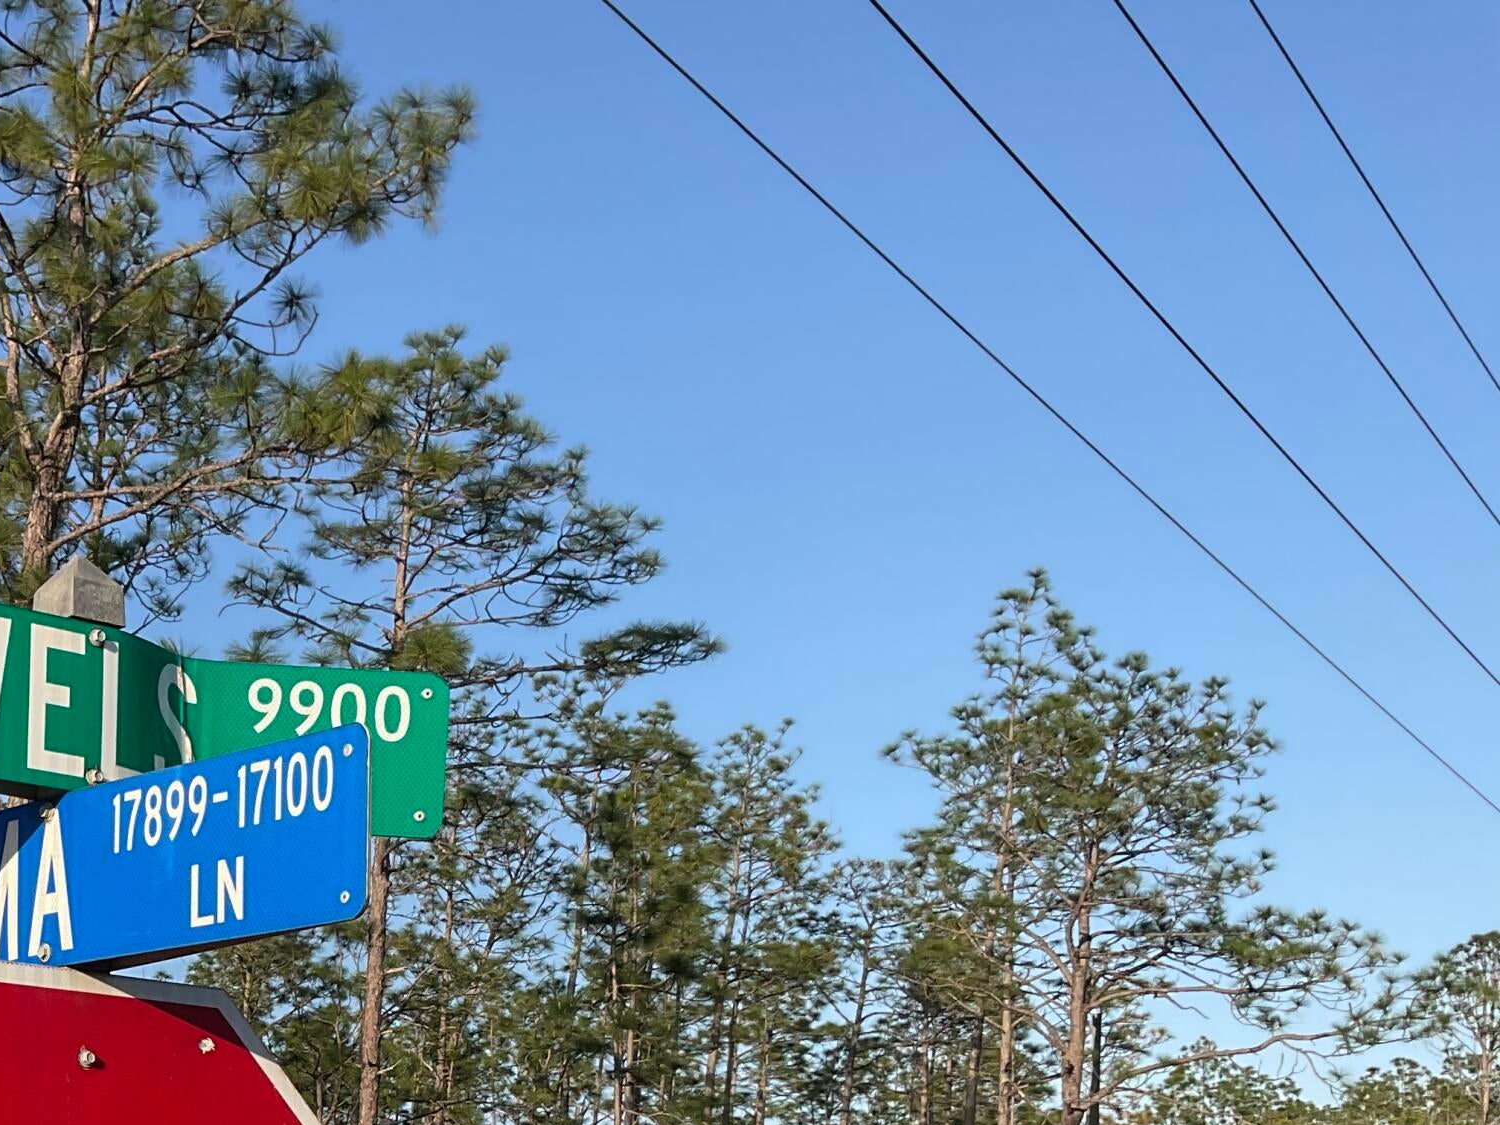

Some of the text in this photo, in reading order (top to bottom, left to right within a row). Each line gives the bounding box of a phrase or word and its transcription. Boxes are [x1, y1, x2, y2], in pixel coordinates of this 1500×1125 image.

[248, 678, 411, 742] 9900
[113, 745, 334, 854] 17899-17100
[190, 856, 244, 928] LN
